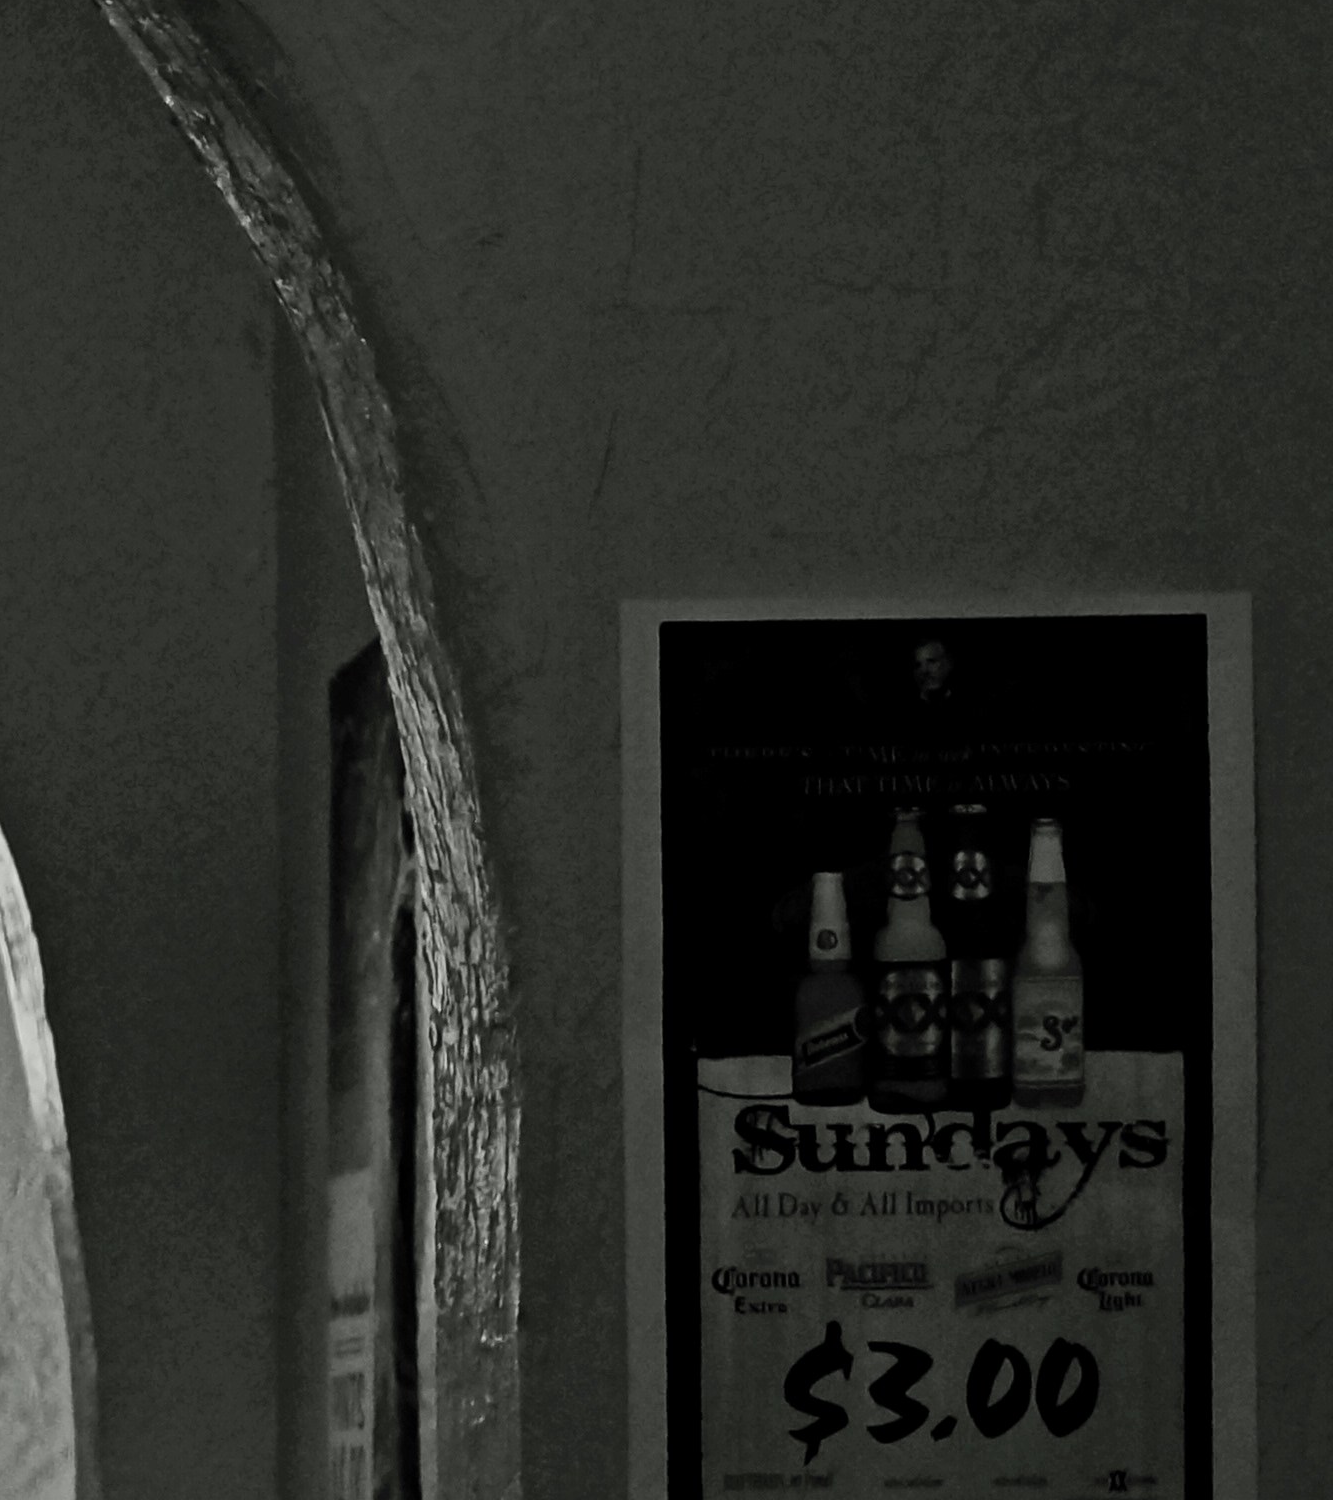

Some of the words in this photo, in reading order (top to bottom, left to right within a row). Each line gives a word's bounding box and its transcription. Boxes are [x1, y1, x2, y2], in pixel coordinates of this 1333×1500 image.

[967, 771, 1072, 795] ALWAYS
[732, 1103, 1171, 1231] Sundays
[730, 1192, 770, 1220] All
[778, 1192, 823, 1224] Day
[831, 1193, 850, 1217] &
[859, 1191, 897, 1217] All
[905, 1190, 995, 1224] Imports
[711, 1266, 801, 1296] Corona
[1076, 1266, 1155, 1292] Corona
[734, 1296, 789, 1315] Extra
[784, 1321, 1100, 1466] $3.00
